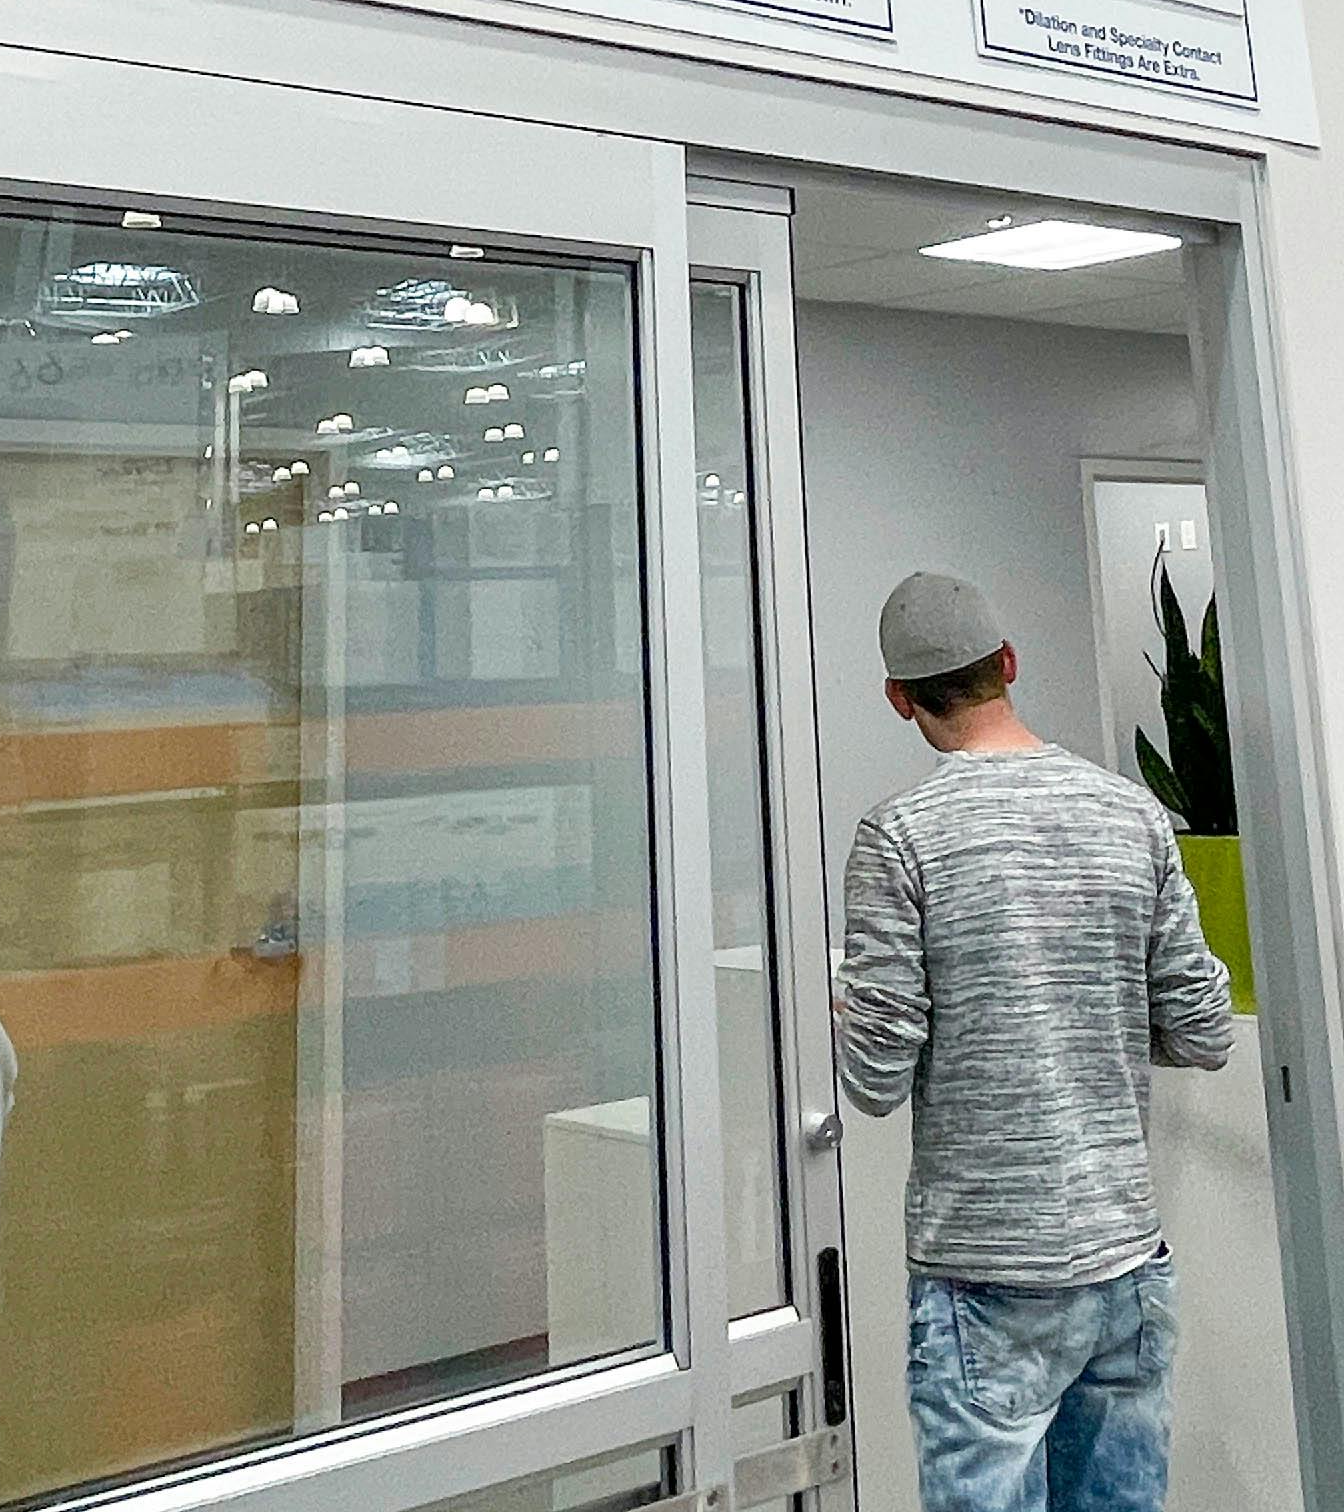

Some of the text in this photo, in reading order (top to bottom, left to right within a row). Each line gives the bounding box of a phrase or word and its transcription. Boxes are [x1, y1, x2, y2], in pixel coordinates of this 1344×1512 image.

[1047, 35, 1200, 81] Lens Fittings Are Extra.
[1081, 24, 1106, 39] and
[1109, 26, 1169, 57] Specialty
[1172, 40, 1222, 65] Contact
